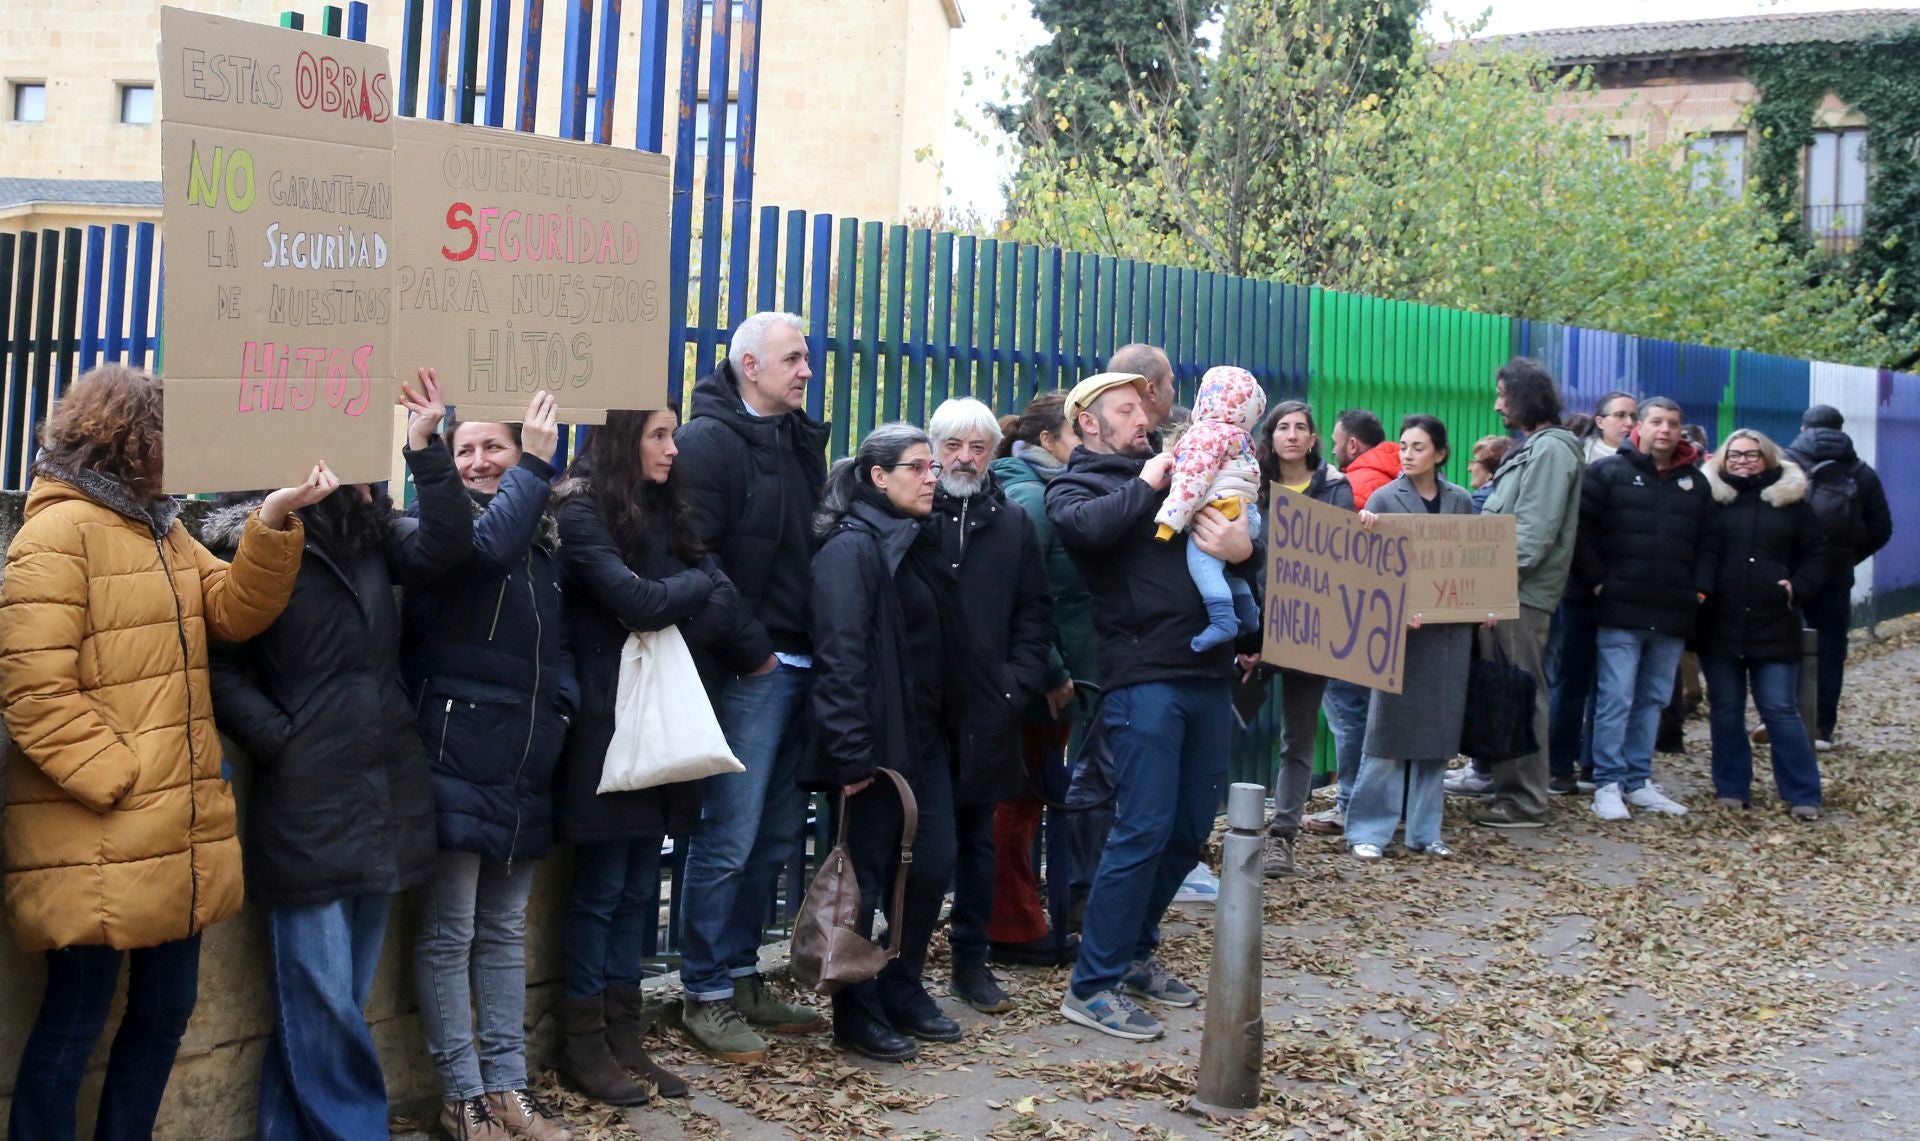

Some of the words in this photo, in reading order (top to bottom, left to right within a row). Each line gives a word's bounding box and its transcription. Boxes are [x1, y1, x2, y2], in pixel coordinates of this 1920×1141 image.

[183, 47, 283, 110] ESTAS
[296, 50, 391, 123] OBRAS
[187, 138, 256, 213] NO
[442, 144, 623, 204] QUEREMOS
[207, 226, 238, 268] LA
[217, 285, 242, 321] DE
[268, 280, 392, 327] NUESTROS
[397, 265, 490, 314] PARA
[511, 273, 660, 325] NUESTROS
[1275, 557, 1312, 590] PARA
[1313, 570, 1330, 597] LA
[1408, 549, 1437, 570] ARA
[1267, 593, 1321, 650] ANEJA
